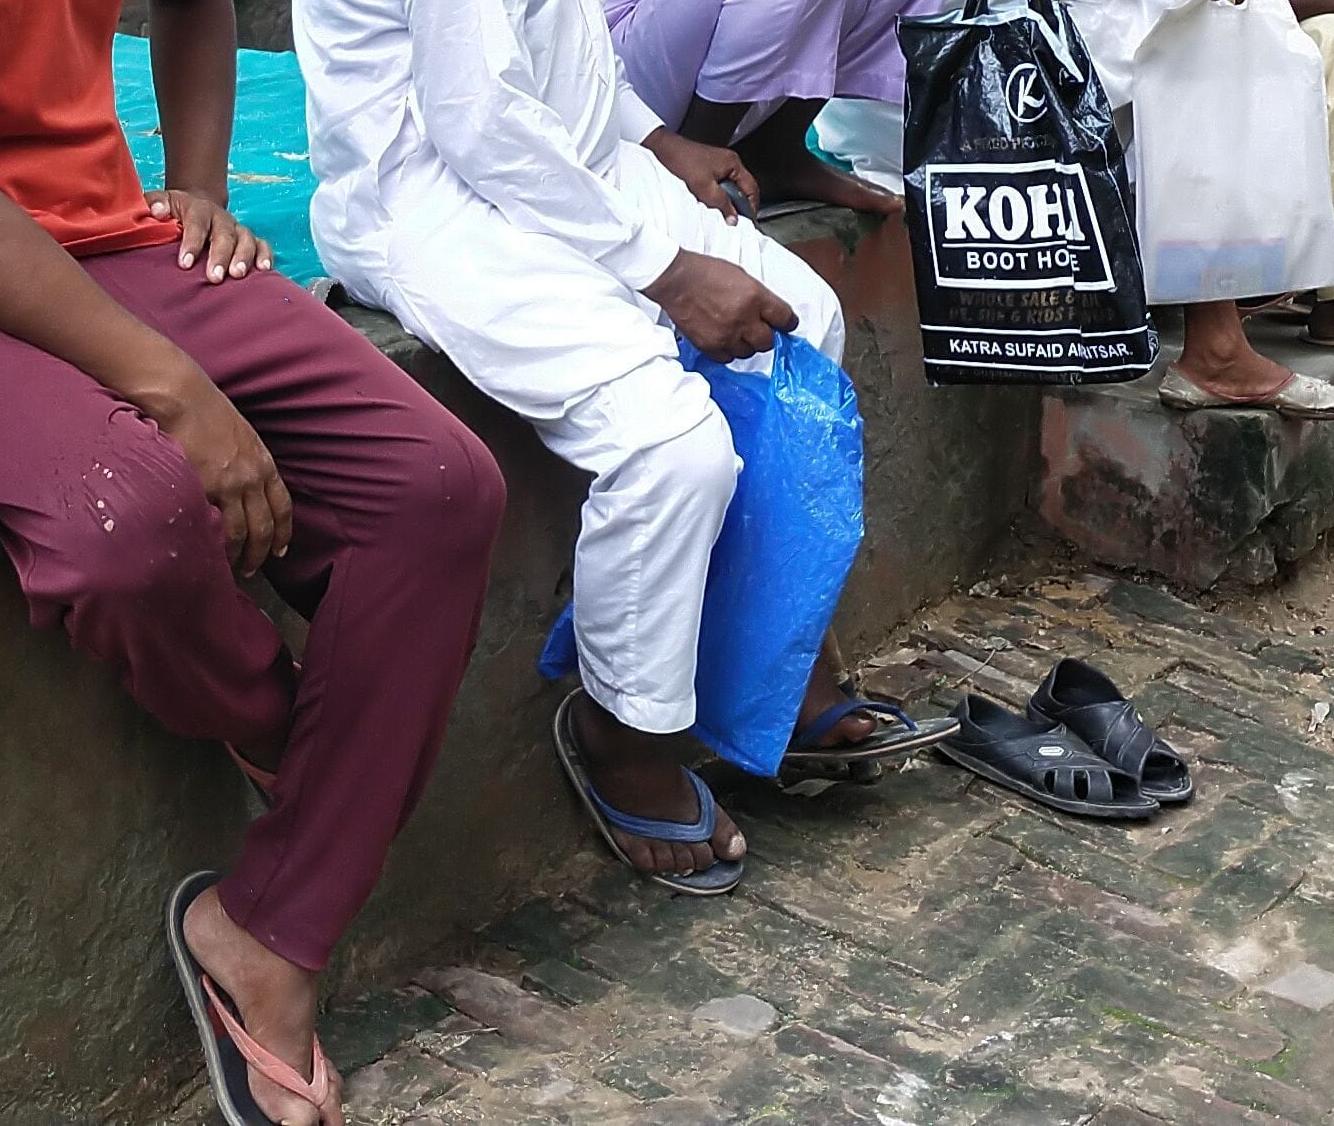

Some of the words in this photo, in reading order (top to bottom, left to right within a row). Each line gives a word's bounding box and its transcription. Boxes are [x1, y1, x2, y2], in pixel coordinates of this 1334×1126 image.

[967, 251, 1028, 270] BOOT
[1037, 248, 1080, 272] HOE
[1020, 289, 1060, 306] SALE
[1026, 306, 1065, 324] KIDS
[949, 338, 1002, 356] KATRA
[1004, 343, 1063, 358] SUFAID
